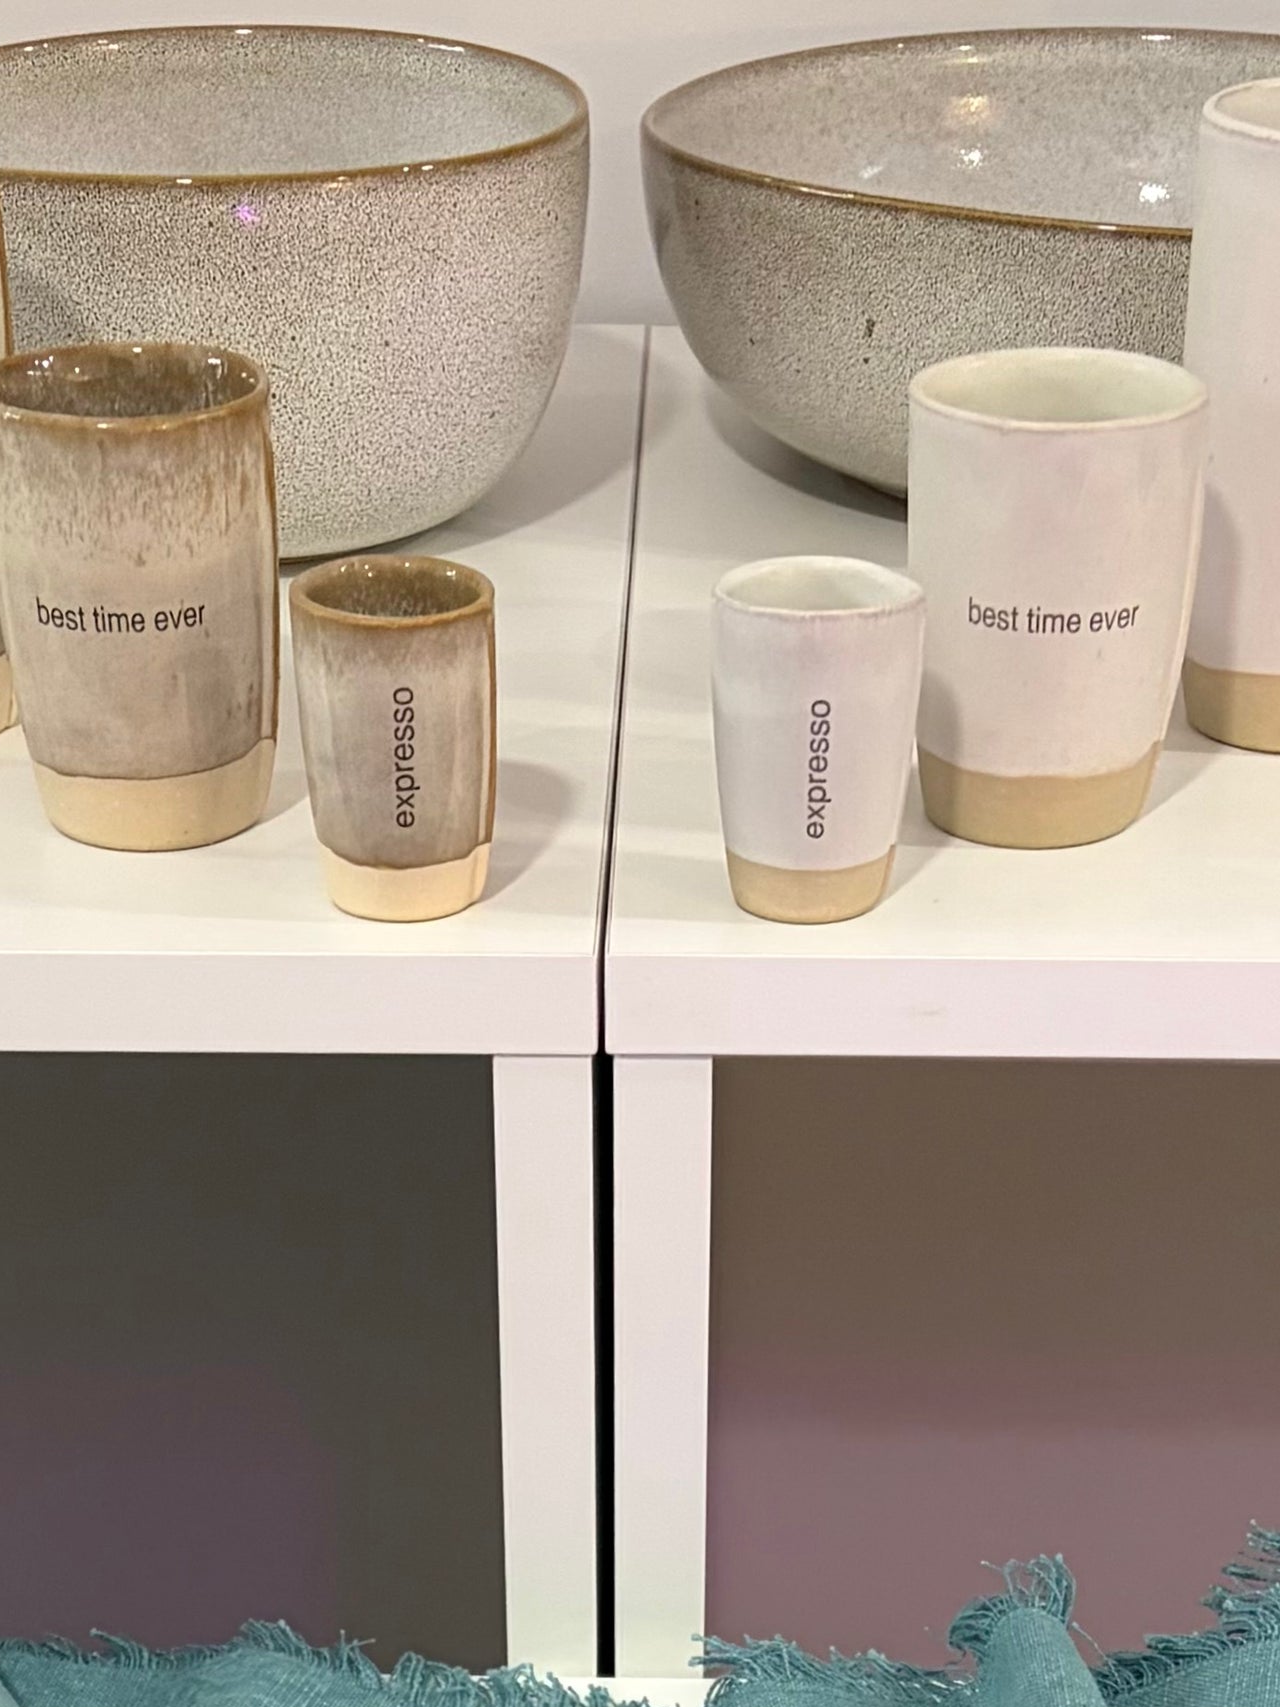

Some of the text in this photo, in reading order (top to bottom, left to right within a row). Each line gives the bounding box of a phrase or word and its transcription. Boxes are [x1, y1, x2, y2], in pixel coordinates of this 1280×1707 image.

[36, 597, 206, 634] best time ever
[969, 596, 1141, 634] best time ever
[392, 686, 420, 829] expresso
[806, 699, 832, 840] expresso
